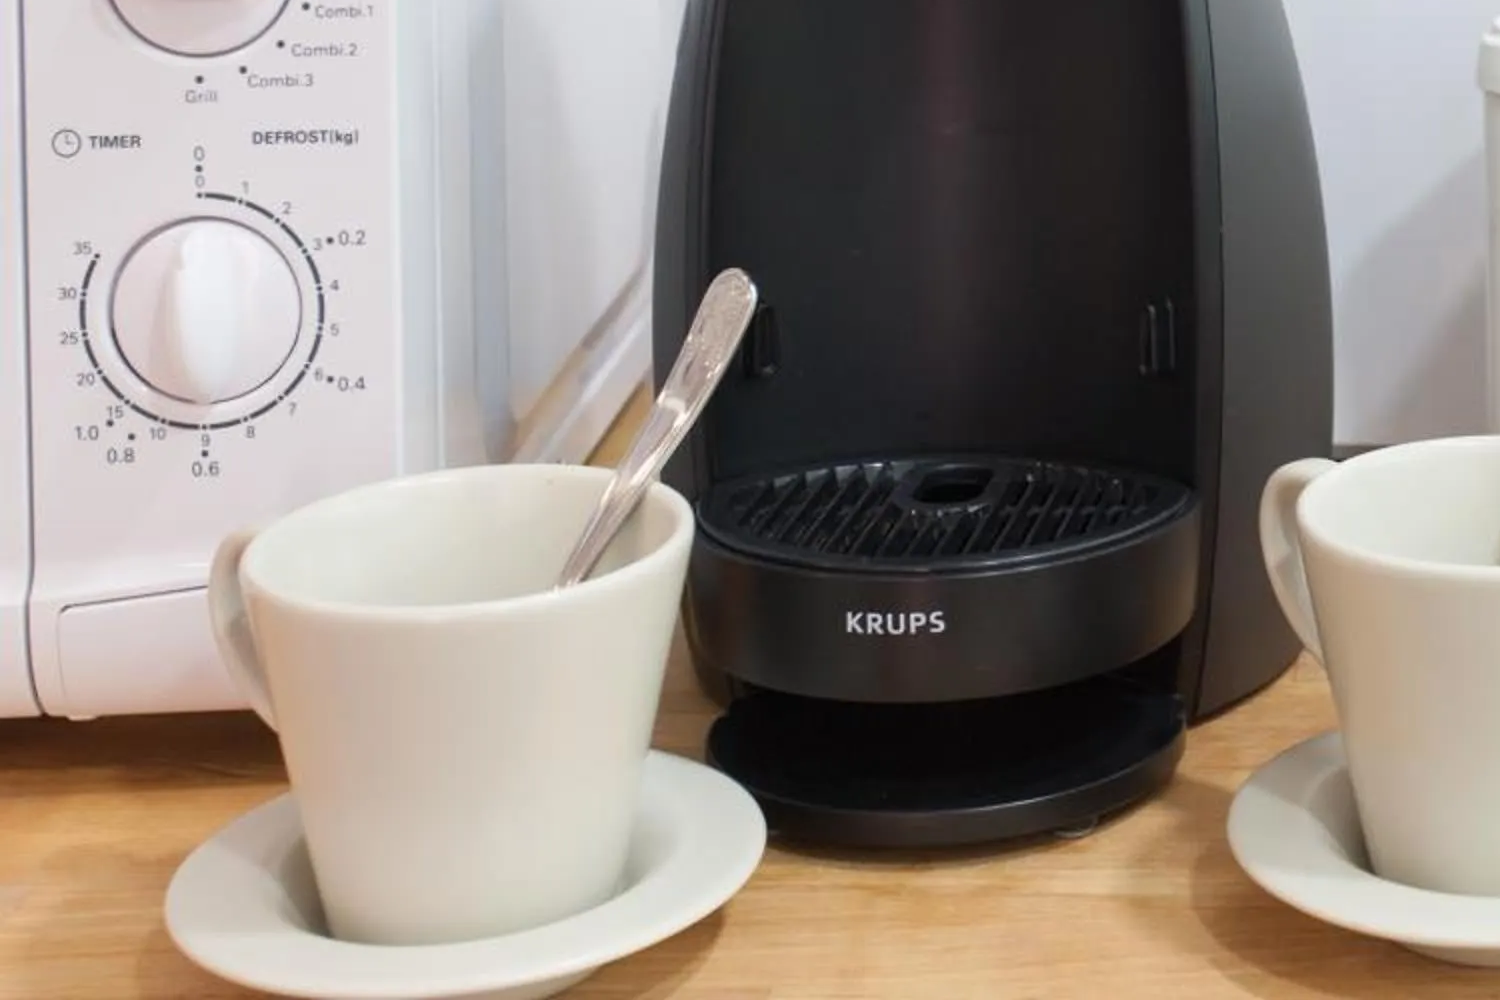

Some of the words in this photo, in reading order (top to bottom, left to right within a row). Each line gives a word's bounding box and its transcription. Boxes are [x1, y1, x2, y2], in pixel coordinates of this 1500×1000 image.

[314, 4, 374, 19] Combi.1
[290, 43, 358, 58] Combi.2
[247, 73, 314, 88] Combi.3
[184, 89, 218, 103] Grill
[88, 135, 142, 150] TIMER
[241, 181, 250, 194] 1
[282, 201, 292, 215] 2
[312, 237, 324, 251] 3
[338, 229, 366, 246] 0.2
[73, 242, 92, 256] 35
[329, 279, 340, 292] 4
[58, 287, 77, 300] 30
[329, 323, 340, 337] 5
[60, 332, 79, 345] 25
[76, 373, 96, 386] 20
[314, 369, 324, 383] 6
[337, 376, 366, 391] 0.4
[107, 405, 125, 419] 15
[289, 404, 297, 417] 7
[75, 426, 99, 441] 1.0
[149, 427, 166, 441] 10
[246, 426, 256, 439] 8
[201, 434, 211, 448] 9
[106, 448, 135, 464] 0.8
[191, 462, 220, 477] 0.6
[846, 611, 946, 635] KRUPS
